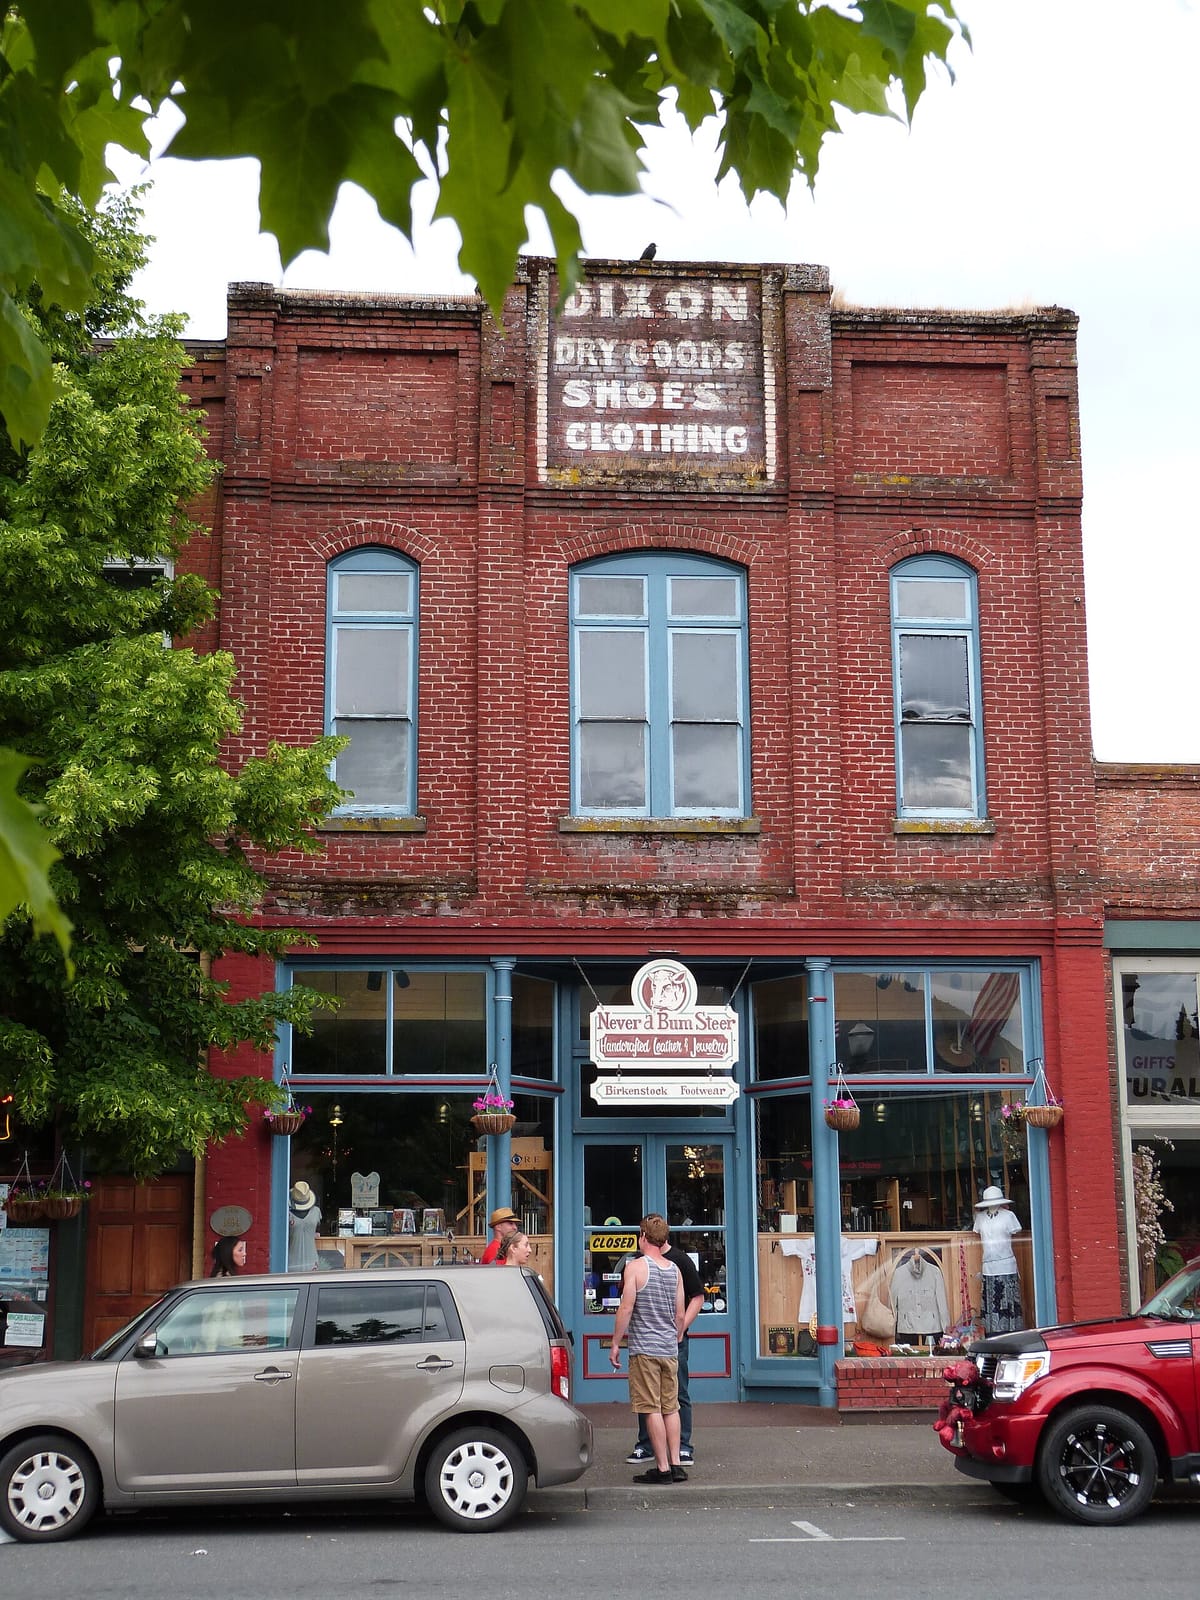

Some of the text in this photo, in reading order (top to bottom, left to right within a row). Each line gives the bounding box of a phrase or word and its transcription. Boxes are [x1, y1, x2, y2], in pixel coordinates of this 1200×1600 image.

[562, 282, 748, 320] DIXON
[555, 337, 745, 368] DRY GOODS
[562, 379, 720, 410] SHOES
[566, 422, 749, 453] CLOTHING
[597, 1011, 736, 1030] Never a Bum Steer
[600, 1037, 650, 1057] Handcrafted
[653, 1036, 682, 1055] Leather
[690, 1037, 728, 1057] Jewelry
[1132, 1056, 1176, 1069] GIFTS
[605, 1085, 726, 1096] Birkenstock Footwear
[592, 1237, 635, 1249] CLOSED
